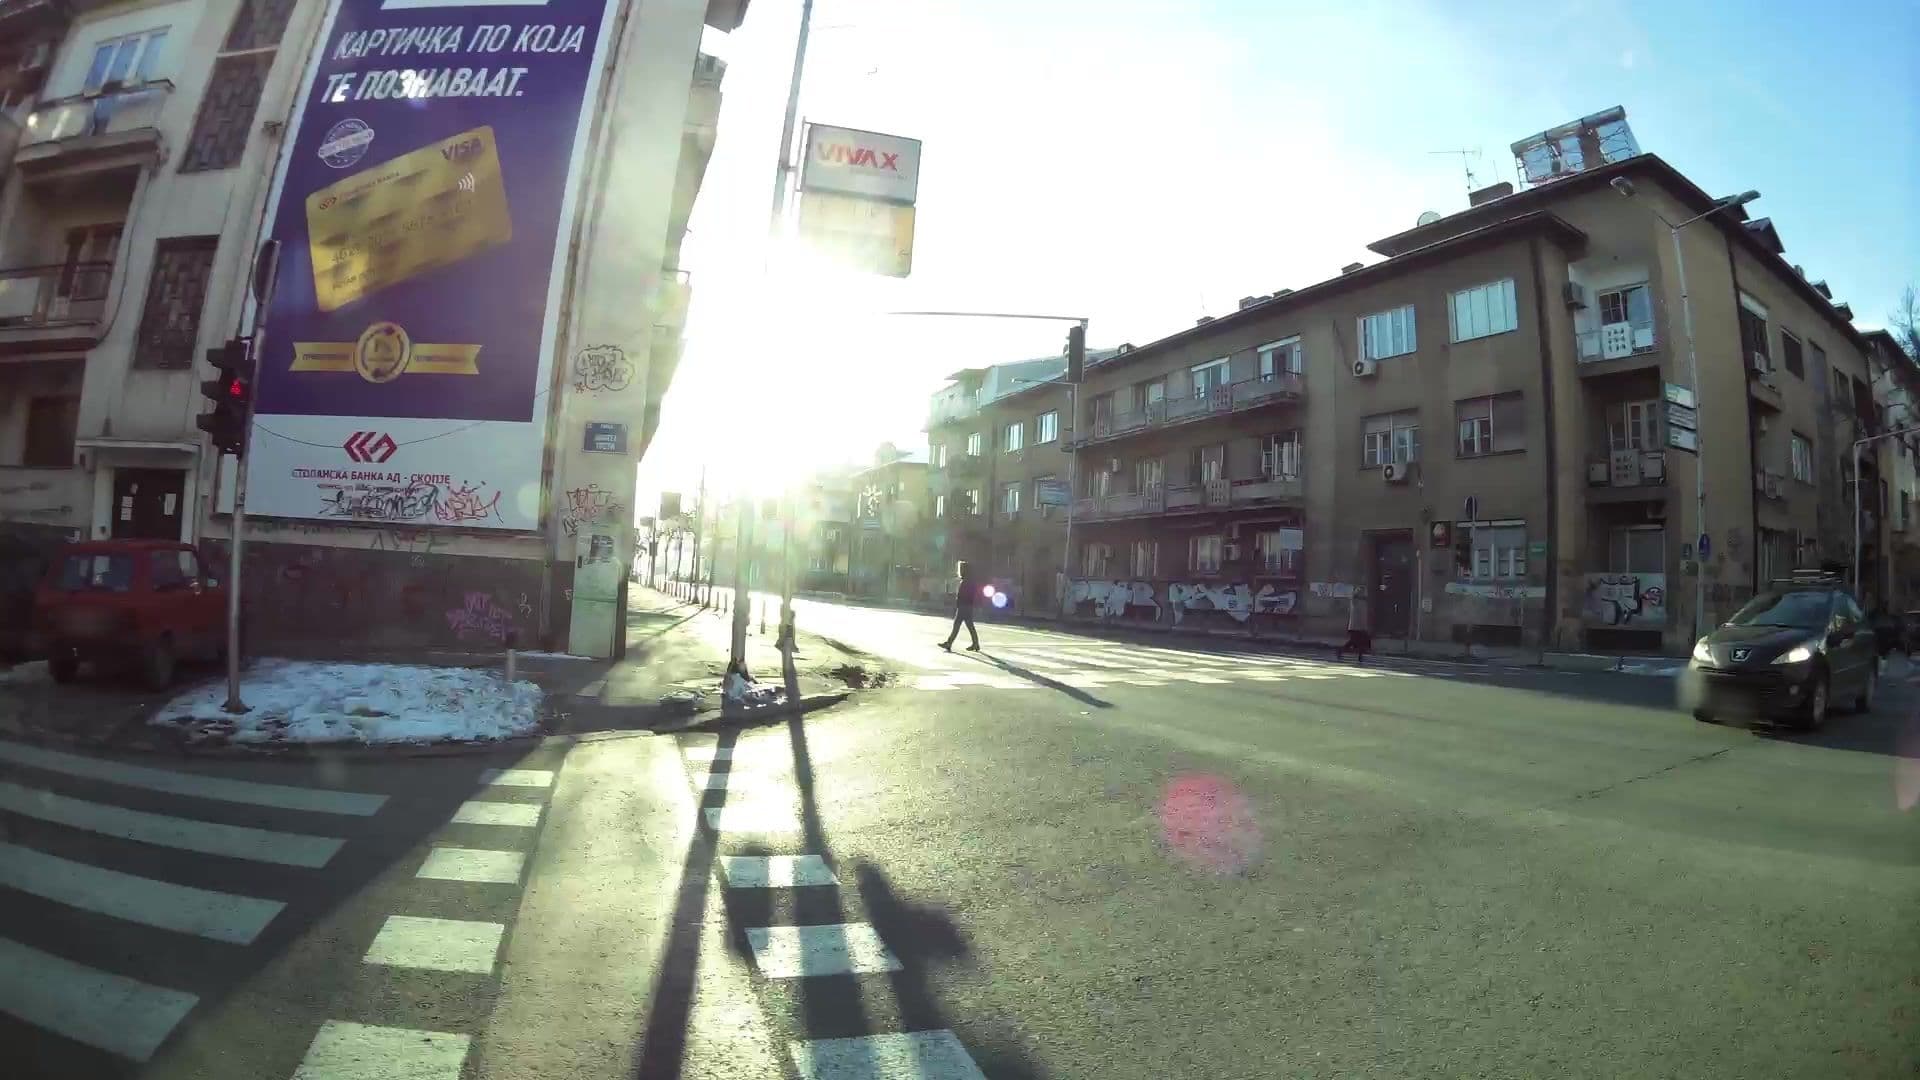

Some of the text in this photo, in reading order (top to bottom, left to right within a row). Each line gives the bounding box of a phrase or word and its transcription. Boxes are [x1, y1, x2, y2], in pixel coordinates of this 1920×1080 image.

[332, 25, 585, 60] КАРТИЧКА ПО КОЈА
[321, 68, 528, 103] ТЕ ПОЗНАВААТ.
[441, 137, 483, 161] VISA
[818, 143, 899, 172] VIVAX
[350, 470, 384, 481] БАНКА
[386, 473, 400, 484] АД
[410, 473, 450, 485] СКОПЈЕ
